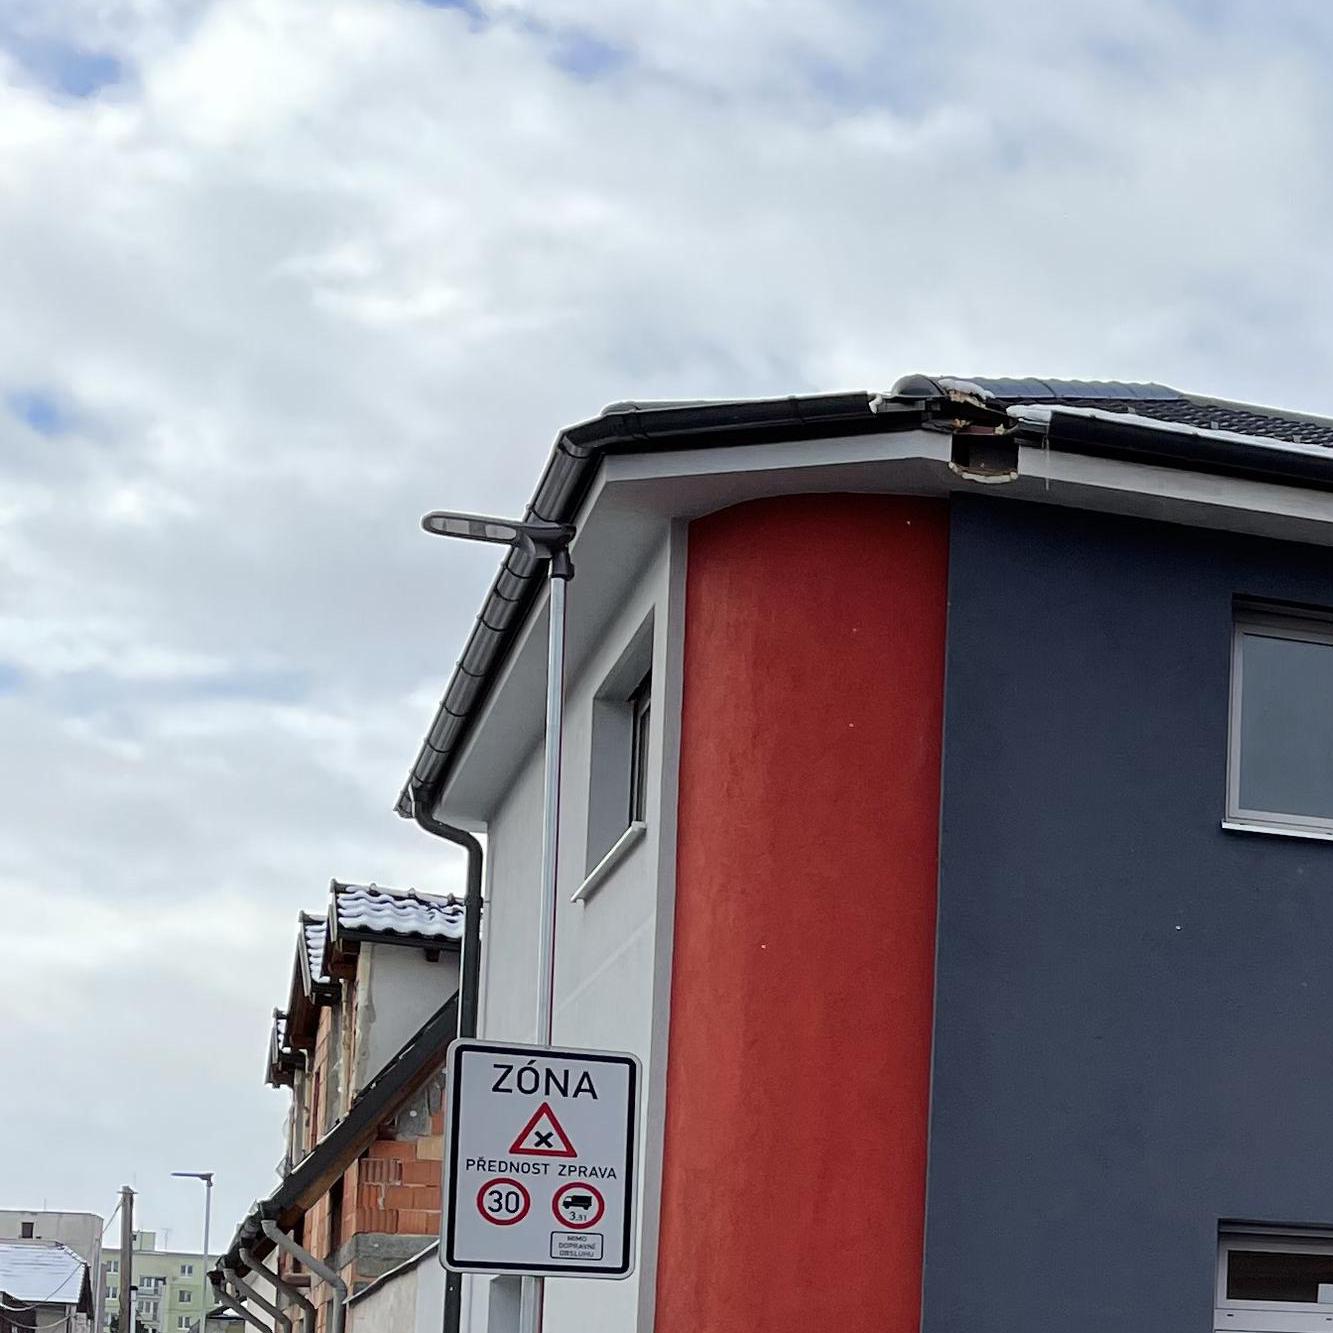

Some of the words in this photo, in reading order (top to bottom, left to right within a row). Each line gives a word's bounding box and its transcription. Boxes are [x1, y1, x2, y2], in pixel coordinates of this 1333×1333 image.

[492, 1060, 598, 1100] ZÓNA
[465, 1156, 549, 1175] PŘEDNOST
[558, 1164, 617, 1180] ZPRAVA
[487, 1189, 520, 1214] 30
